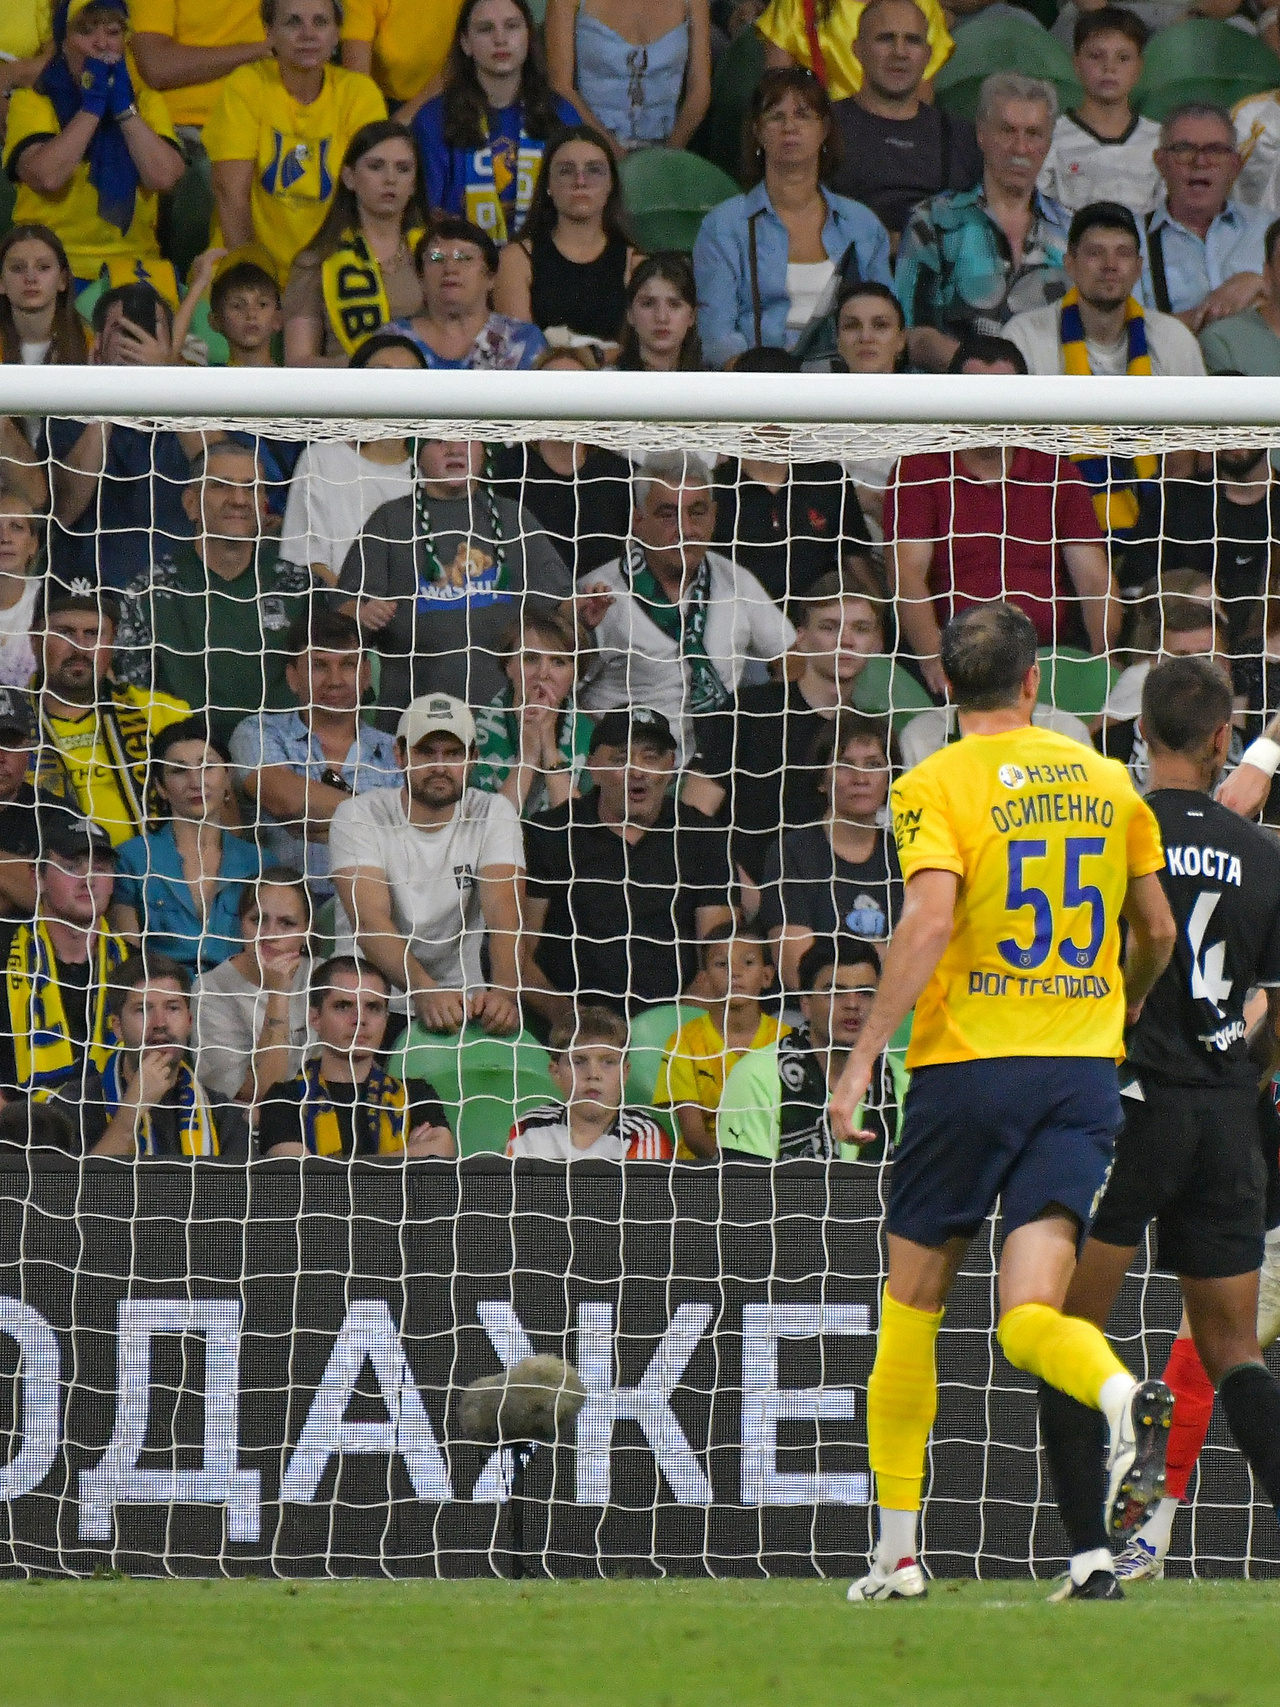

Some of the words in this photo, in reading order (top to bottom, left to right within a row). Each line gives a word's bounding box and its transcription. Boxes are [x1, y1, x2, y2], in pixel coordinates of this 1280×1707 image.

[1026, 763, 1089, 783] НЗНП
[894, 808, 923, 833] ON
[990, 793, 1114, 833] ОСИПЕНКО
[896, 826, 920, 851] ET
[1166, 846, 1242, 887] КОСТА
[995, 837, 1106, 970] 55
[1187, 891, 1234, 1020] 4
